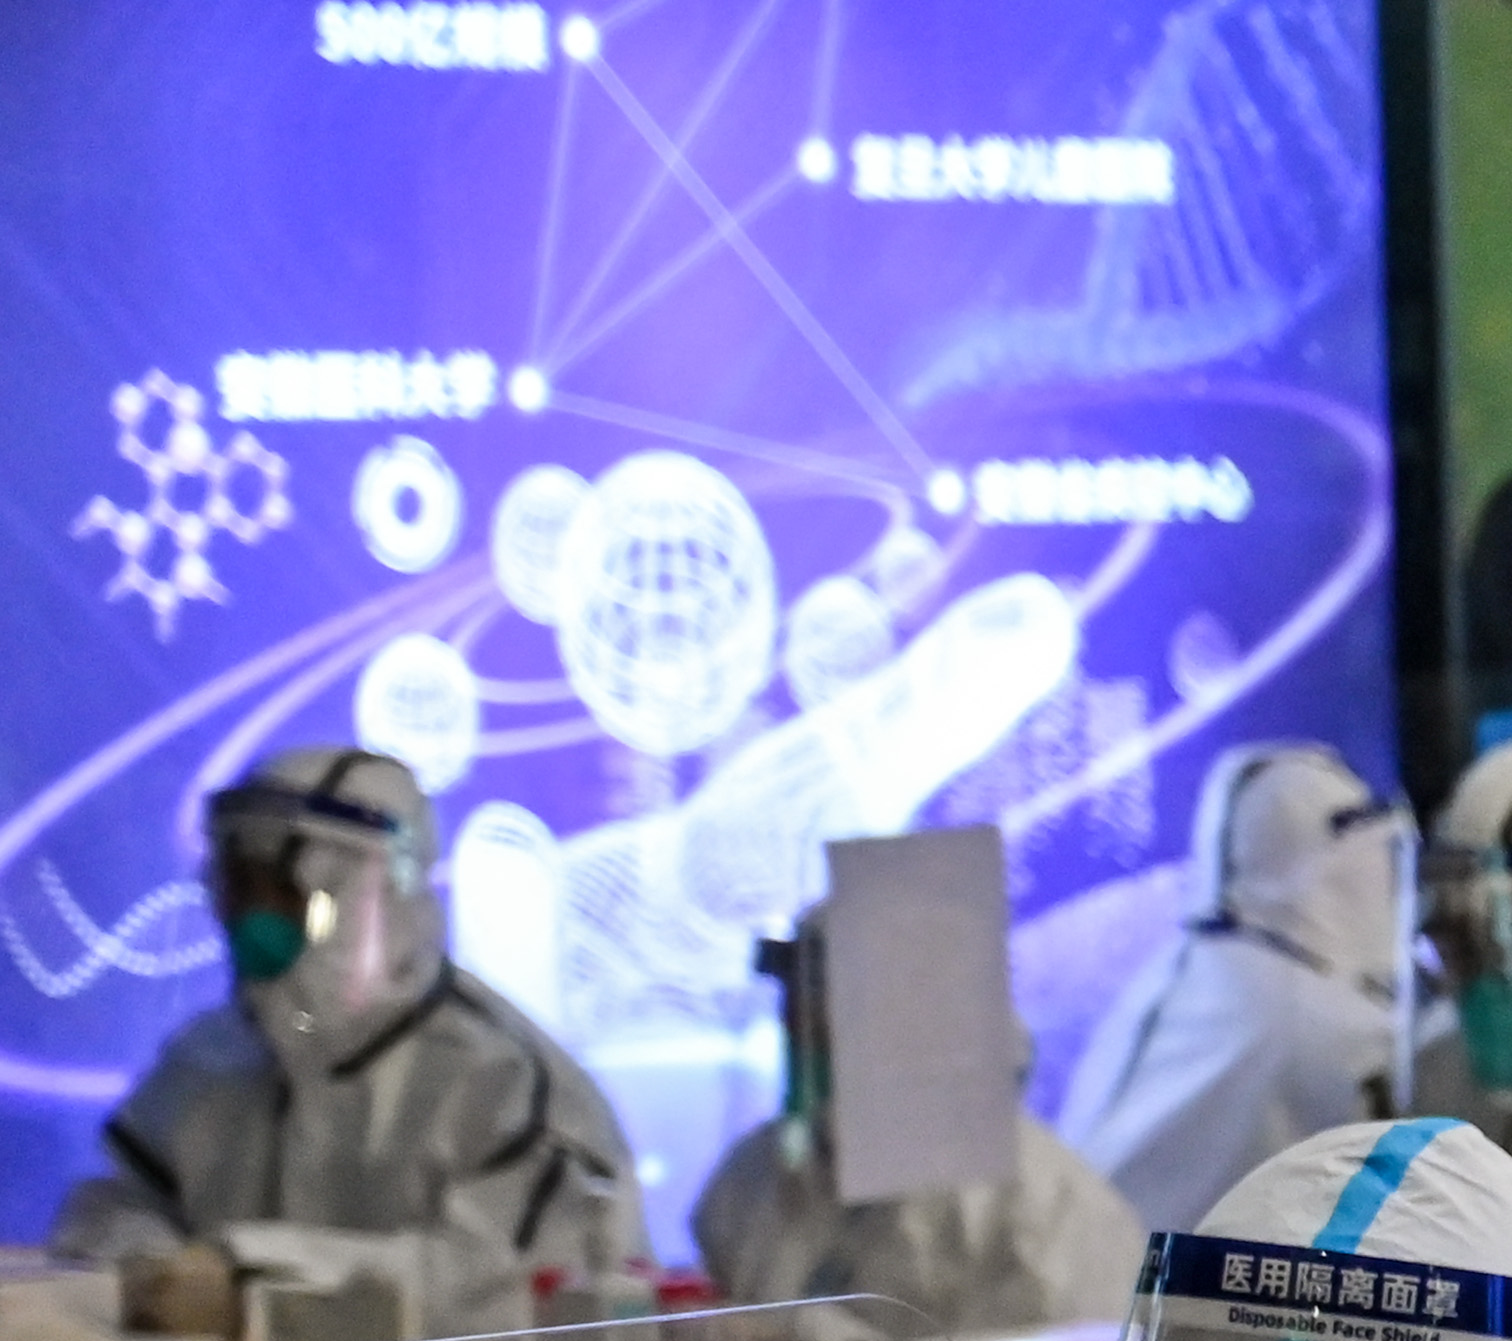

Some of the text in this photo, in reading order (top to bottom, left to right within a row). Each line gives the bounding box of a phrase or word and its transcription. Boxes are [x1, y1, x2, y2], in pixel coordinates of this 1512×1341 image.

[1221, 1252, 1460, 1319] 医用隔离面罩
[1228, 1306, 1327, 1335] Disposable
[1333, 1320, 1376, 1341] Face
